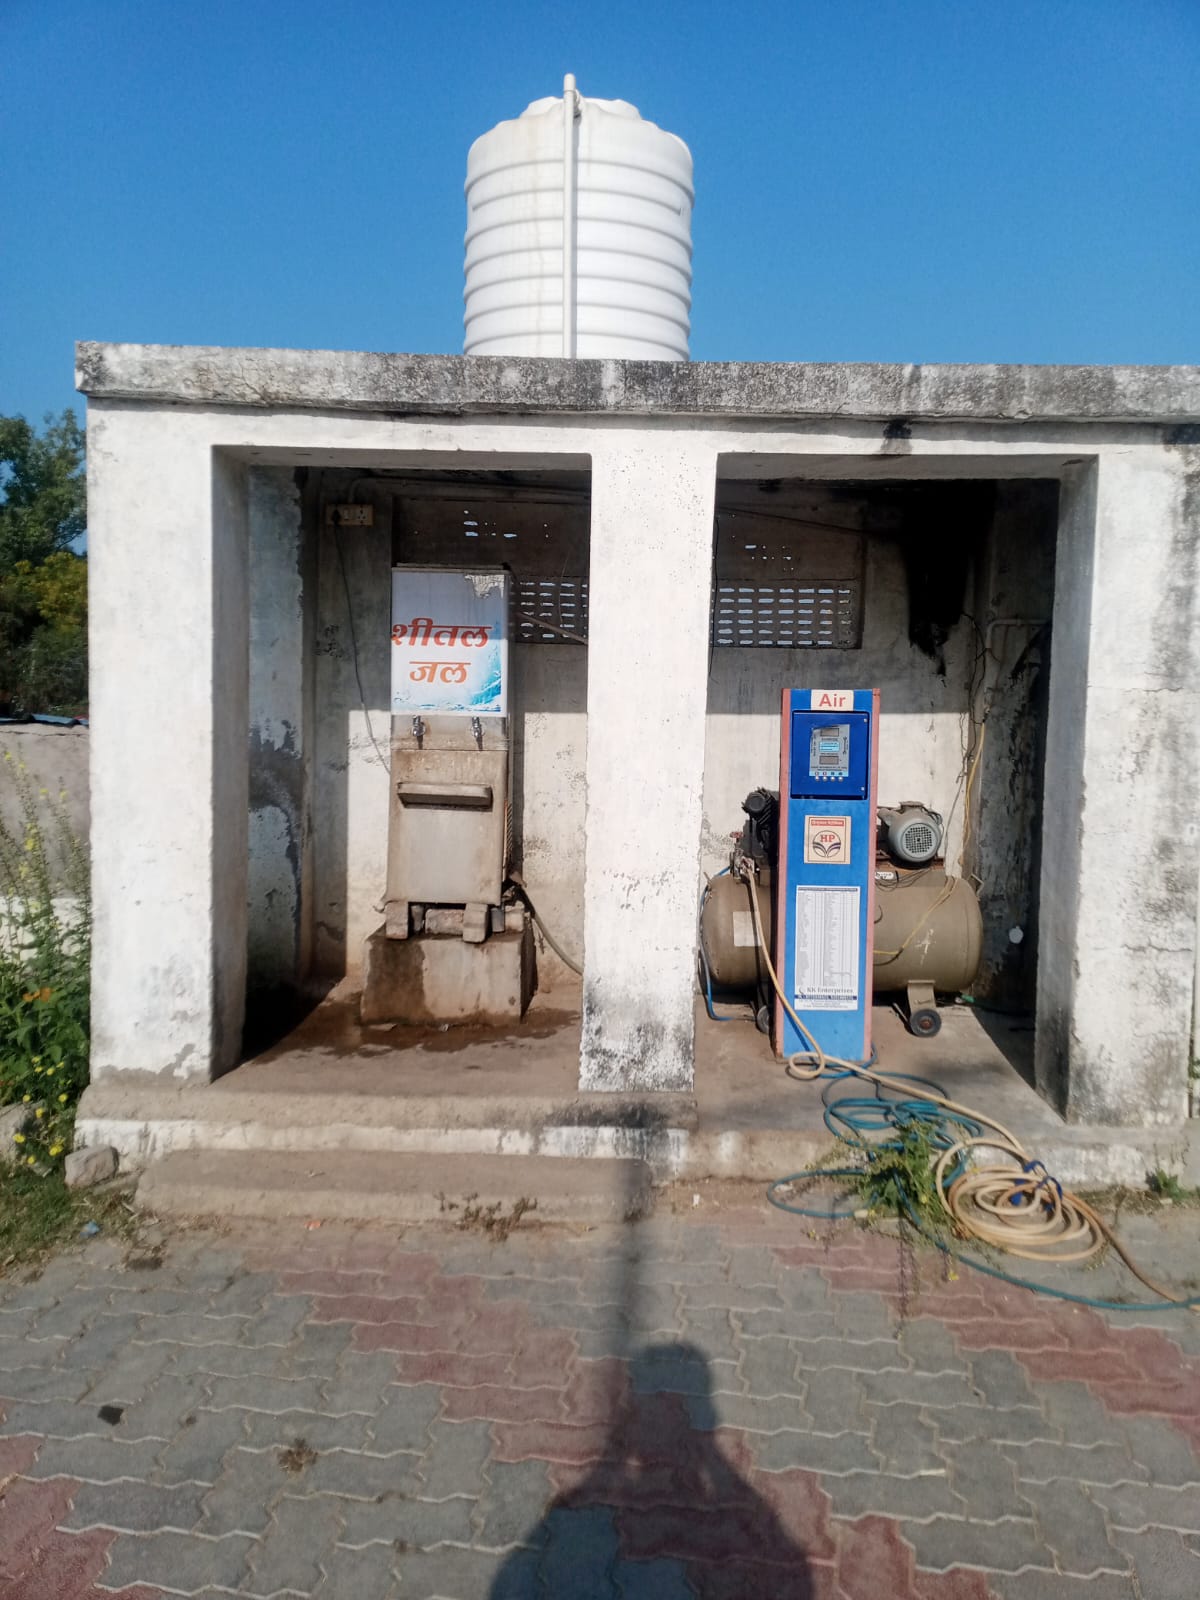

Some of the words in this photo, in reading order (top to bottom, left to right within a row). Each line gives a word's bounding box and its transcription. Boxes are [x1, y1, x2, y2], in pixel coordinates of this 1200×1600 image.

[391, 617, 492, 648] शीतल
[409, 661, 471, 683] जल
[819, 693, 846, 707] Air
[820, 834, 836, 843] HP
